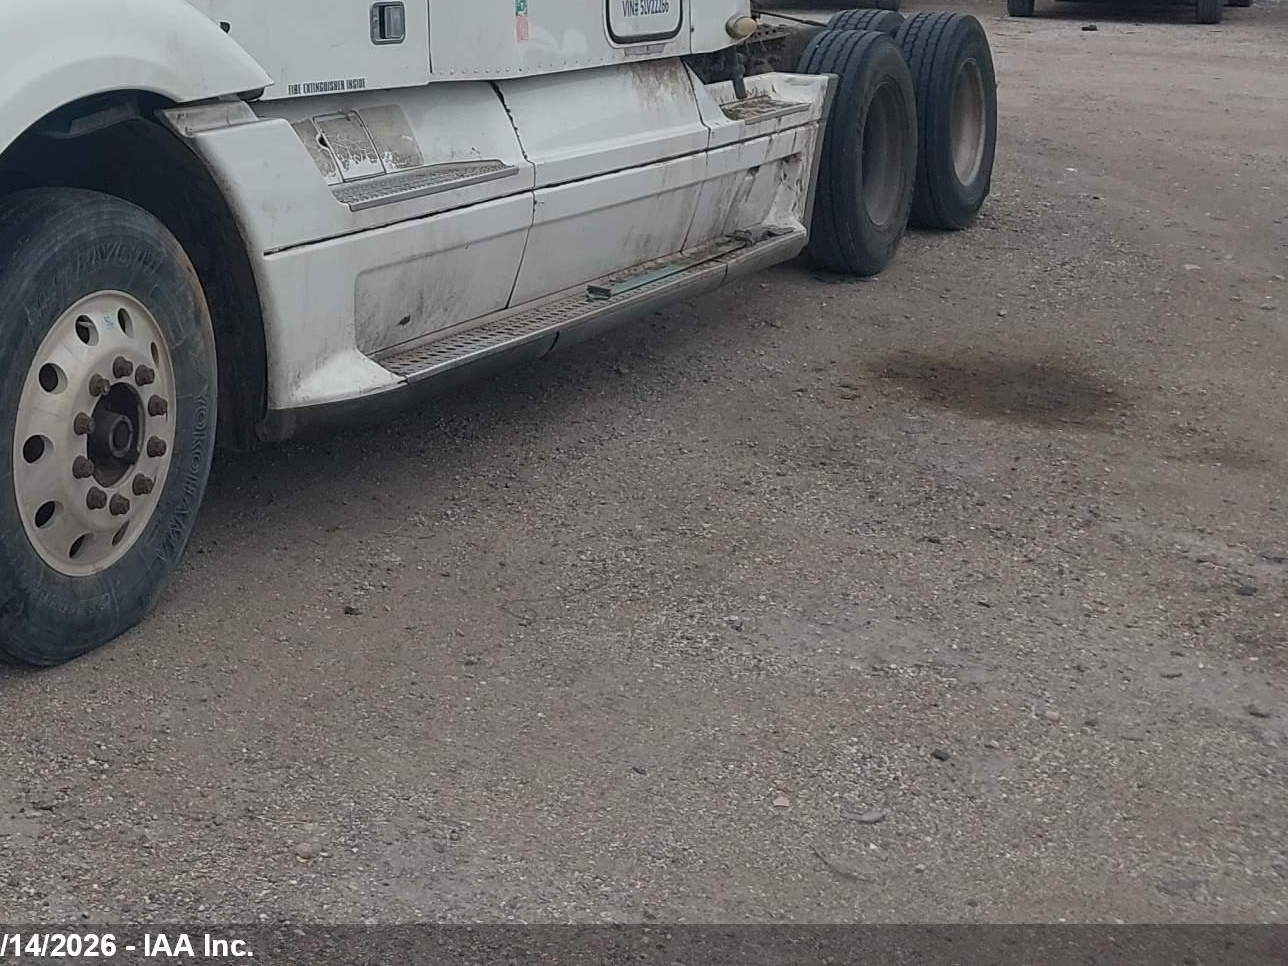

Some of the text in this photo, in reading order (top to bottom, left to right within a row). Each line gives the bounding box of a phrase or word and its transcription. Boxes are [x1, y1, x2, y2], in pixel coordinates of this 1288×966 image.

[288, 77, 366, 96] FIRE EXTINGUISHER INSIDE
